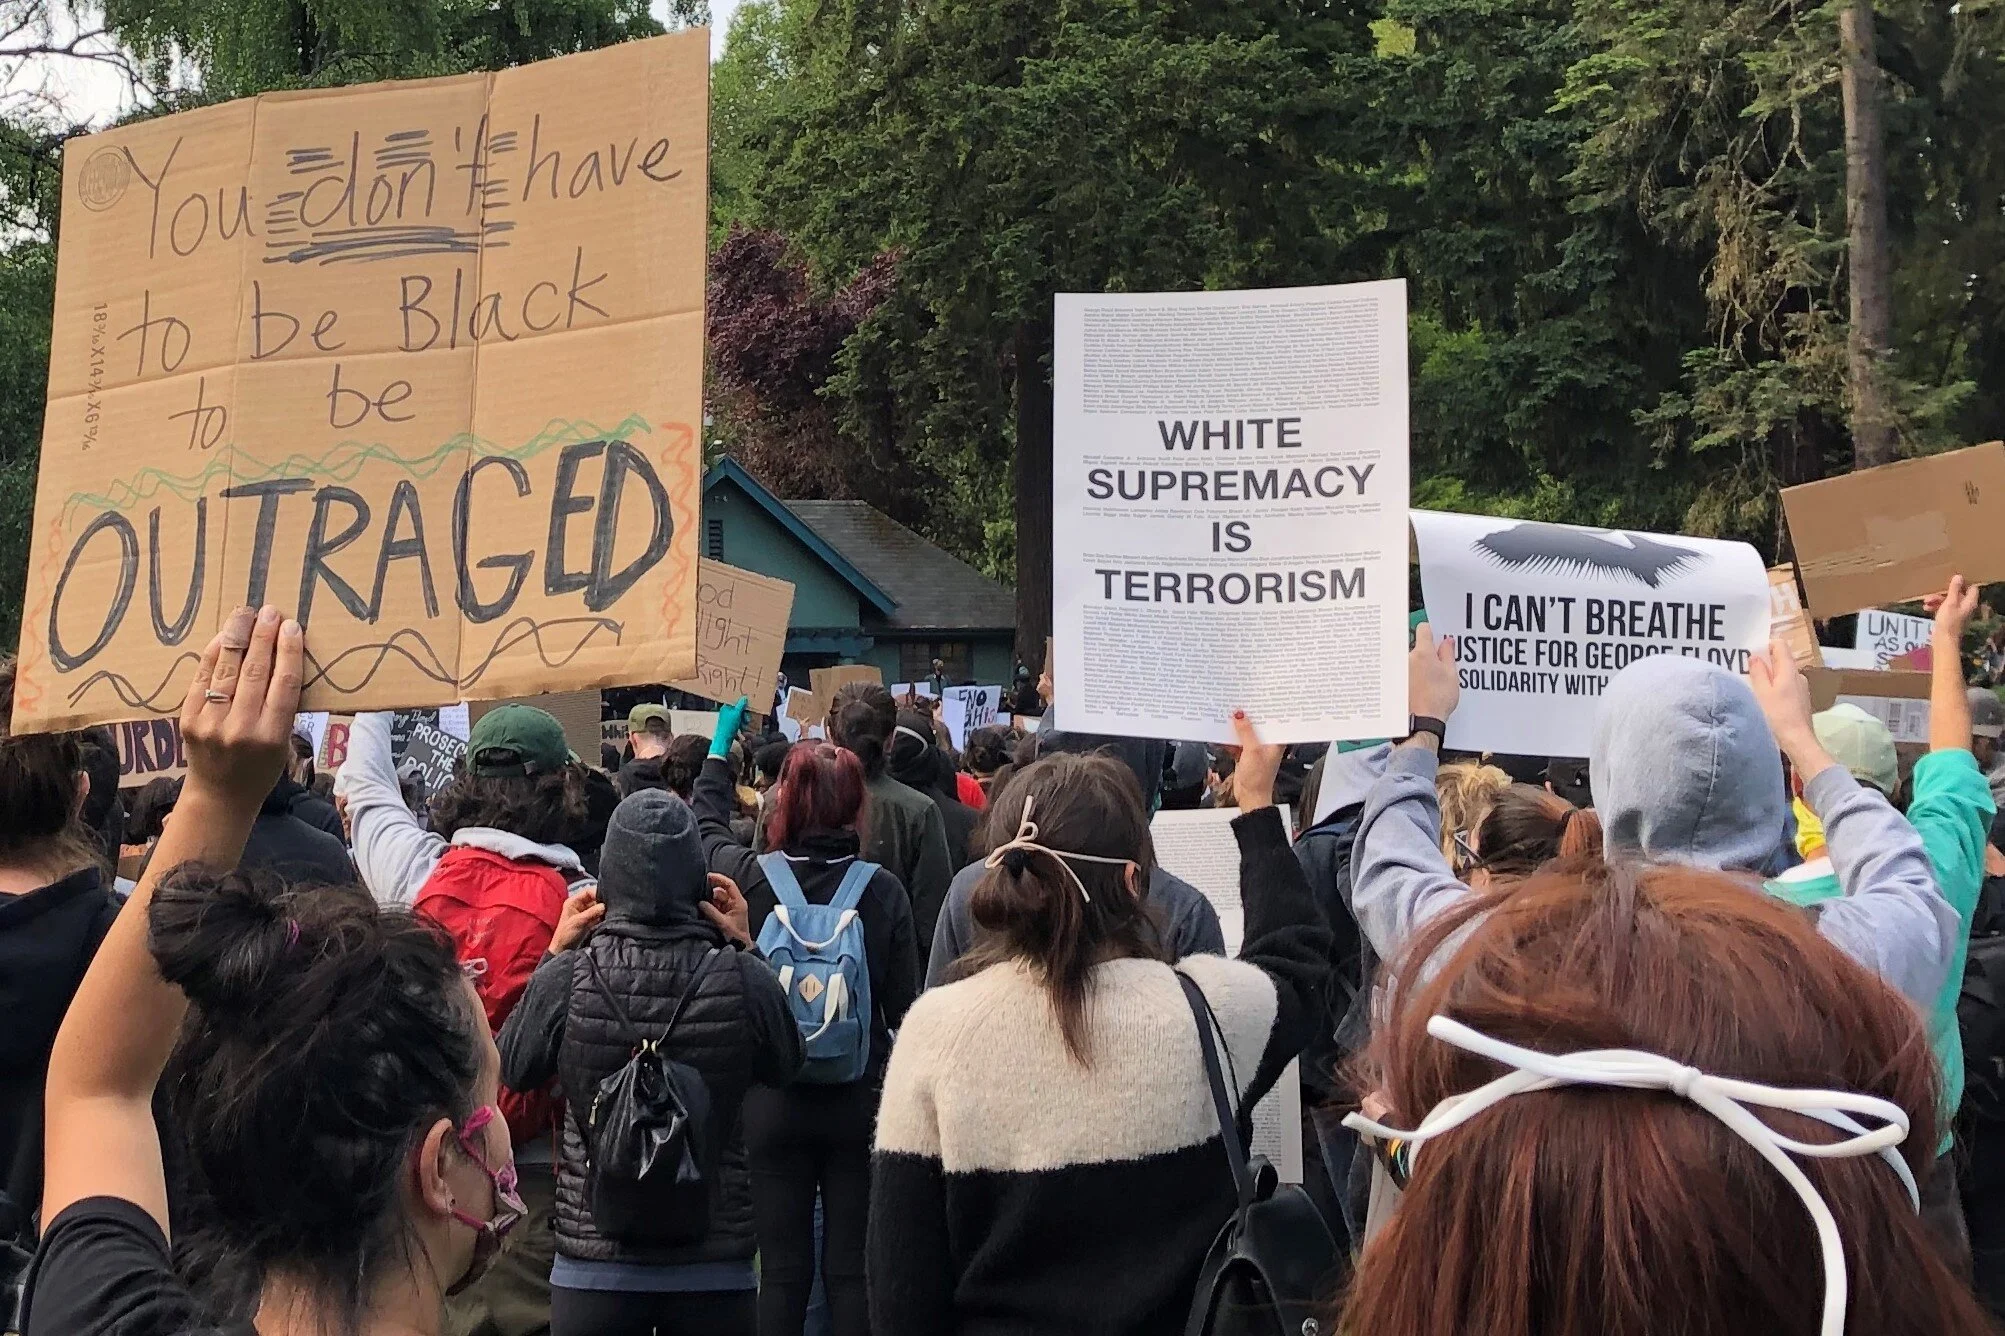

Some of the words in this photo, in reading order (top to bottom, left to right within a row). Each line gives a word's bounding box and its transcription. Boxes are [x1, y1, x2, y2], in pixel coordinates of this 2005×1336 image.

[124, 136, 257, 259] You
[300, 113, 496, 228] don't
[522, 113, 682, 202] have
[117, 289, 191, 376] to
[251, 280, 346, 359] be
[400, 246, 609, 353] Black
[169, 378, 227, 449] to
[328, 364, 416, 429] be
[1158, 417, 1302, 450] WHITE
[1086, 463, 1376, 500] SUPREMACY
[1212, 521, 1252, 552] IS
[49, 439, 674, 673] OUTRAGED
[698, 581, 735, 609] od
[1095, 567, 1365, 605] TERRORISM
[1466, 593, 1473, 629] I
[1483, 593, 1576, 634] CAN'T
[1586, 598, 1726, 641] BREATHE
[1868, 613, 1932, 640] UNIT
[1444, 633, 1527, 666] USTICE
[1535, 639, 1578, 668] FOR
[1874, 636, 1899, 651] AS
[1459, 668, 1559, 694] SOLIDARITY
[1564, 674, 1609, 696] WITH
[404, 756, 454, 790] POLIC
[431, 749, 455, 772] THE
